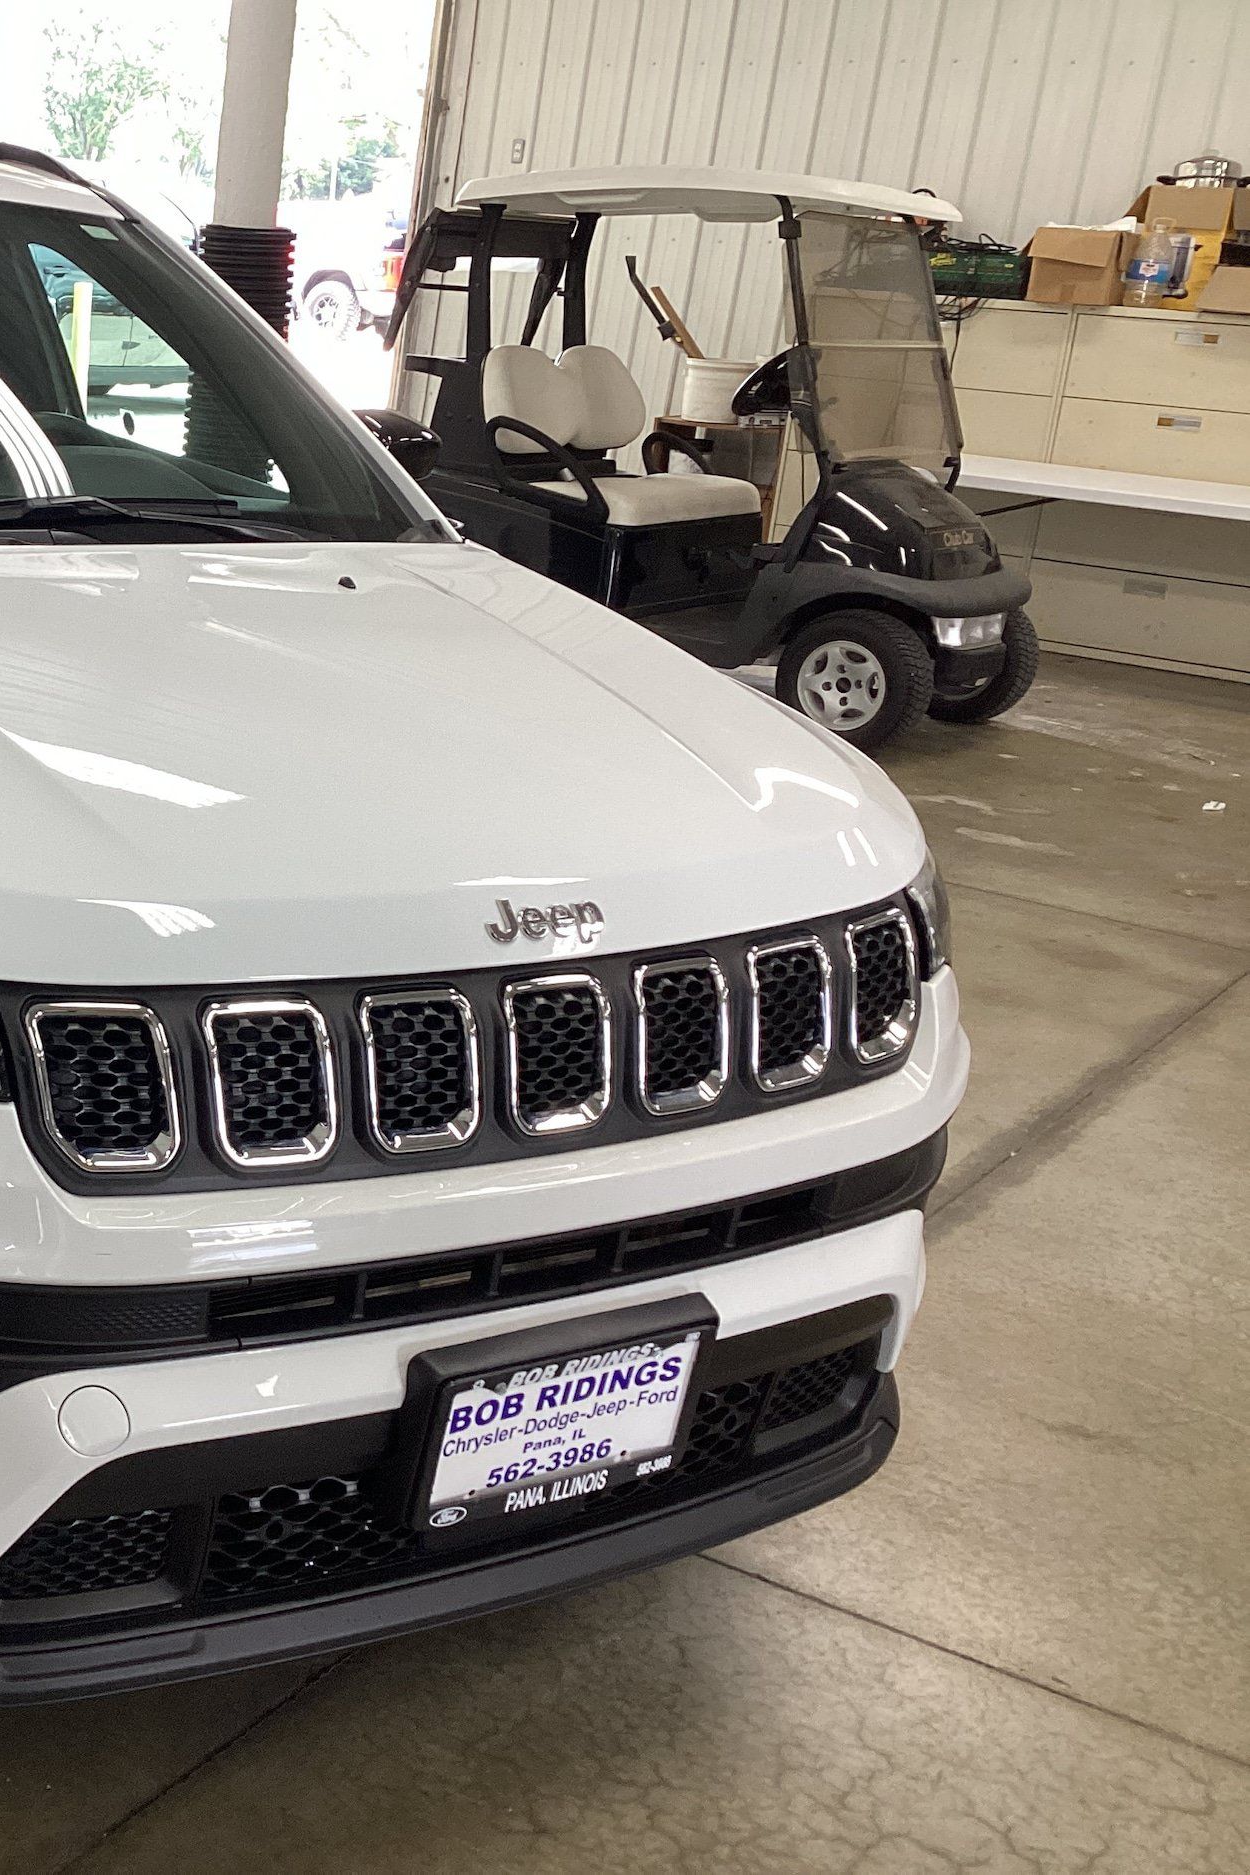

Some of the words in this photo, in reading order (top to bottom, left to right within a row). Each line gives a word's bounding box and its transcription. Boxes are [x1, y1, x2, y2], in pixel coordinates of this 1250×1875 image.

[484, 898, 606, 945] Jeep
[507, 1364, 559, 1388] BOB
[562, 1343, 655, 1376] RIDINGS
[449, 1393, 523, 1434] BOB
[536, 1356, 682, 1412] RIDINGS
[486, 1438, 612, 1488] 562-3986
[523, 1435, 566, 1453] Pana,
[572, 1428, 586, 1441] IL
[550, 1469, 609, 1501] ILLINOIS
